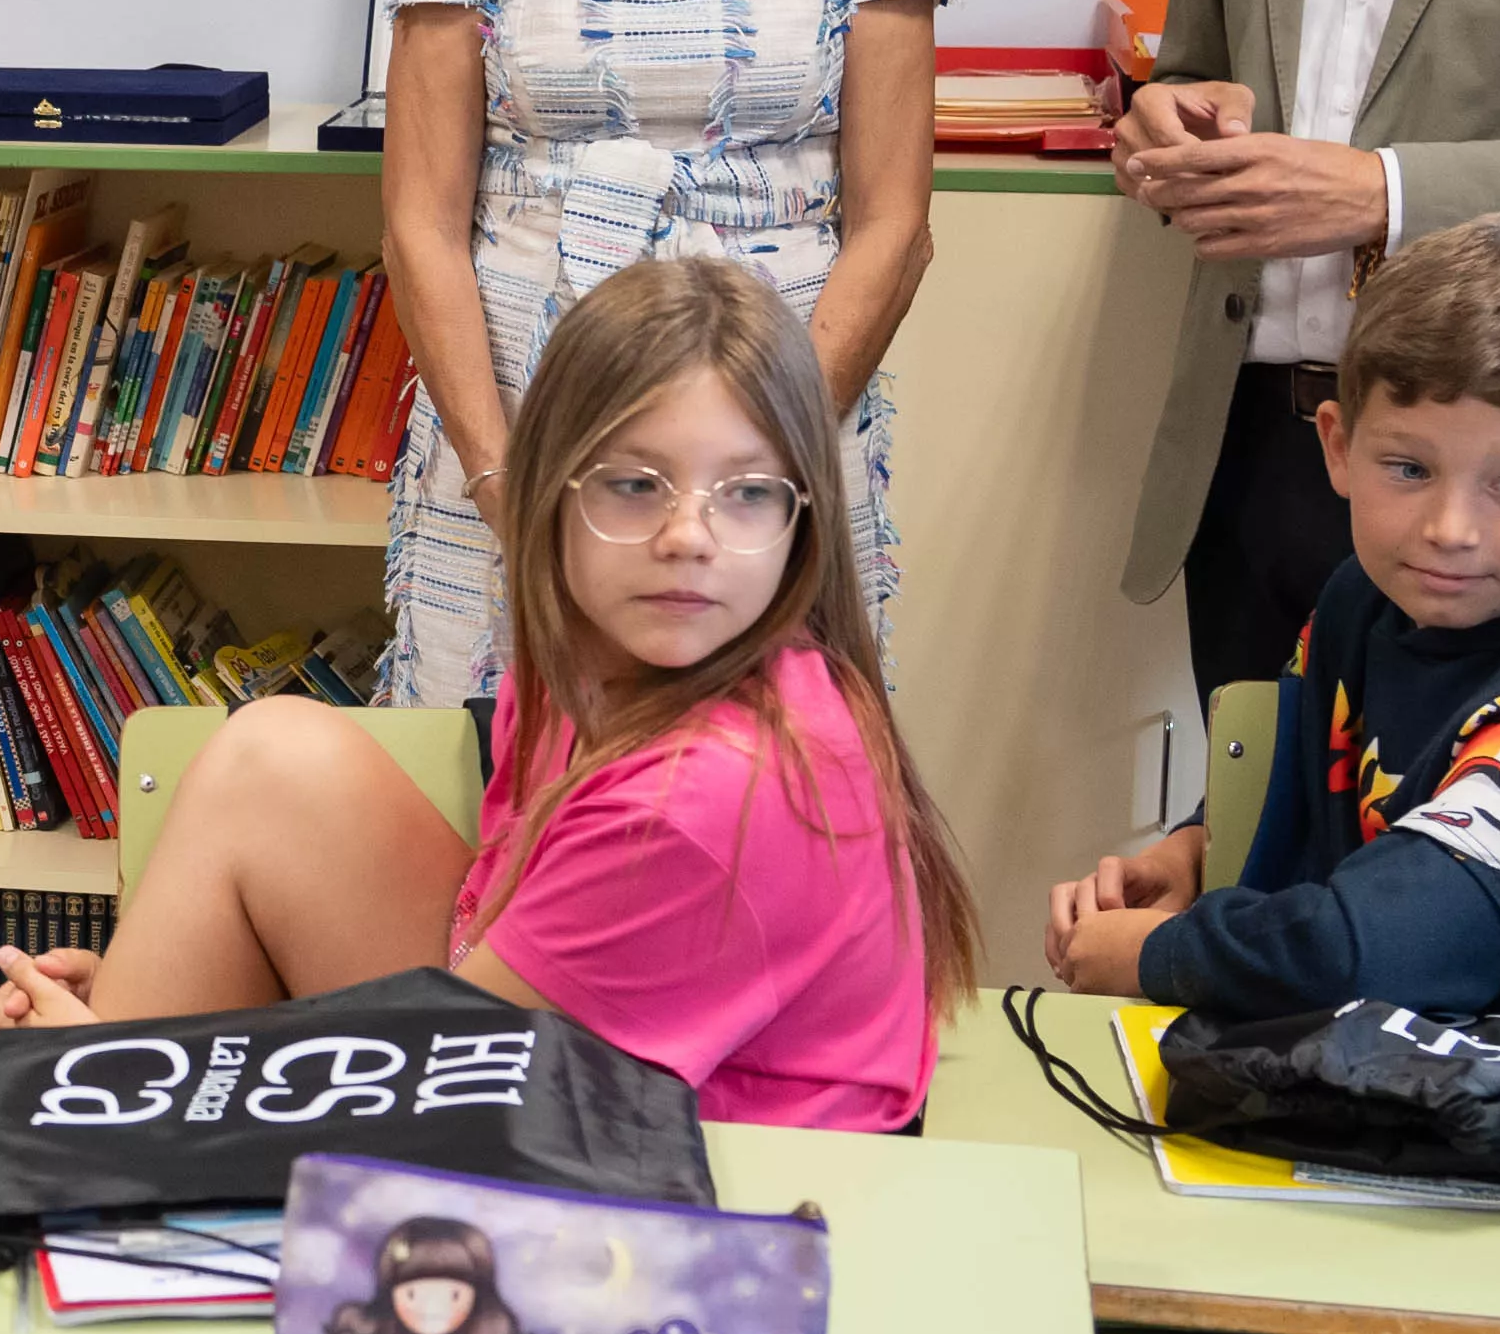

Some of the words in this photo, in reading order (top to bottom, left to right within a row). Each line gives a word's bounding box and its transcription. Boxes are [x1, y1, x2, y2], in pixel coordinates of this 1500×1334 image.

[71, 307, 86, 340] yanqui
[70, 340, 77, 354] en
[63, 364, 73, 383] corte
[58, 385, 68, 404] del
[53, 671, 73, 708] ESCUELA
[2, 685, 22, 728] realidad
[69, 707, 79, 719] LA
[38, 729, 54, 755] VACAS
[53, 730, 69, 756] VACAS
[30, 1037, 191, 1126] ca
[244, 1036, 407, 1123] es
